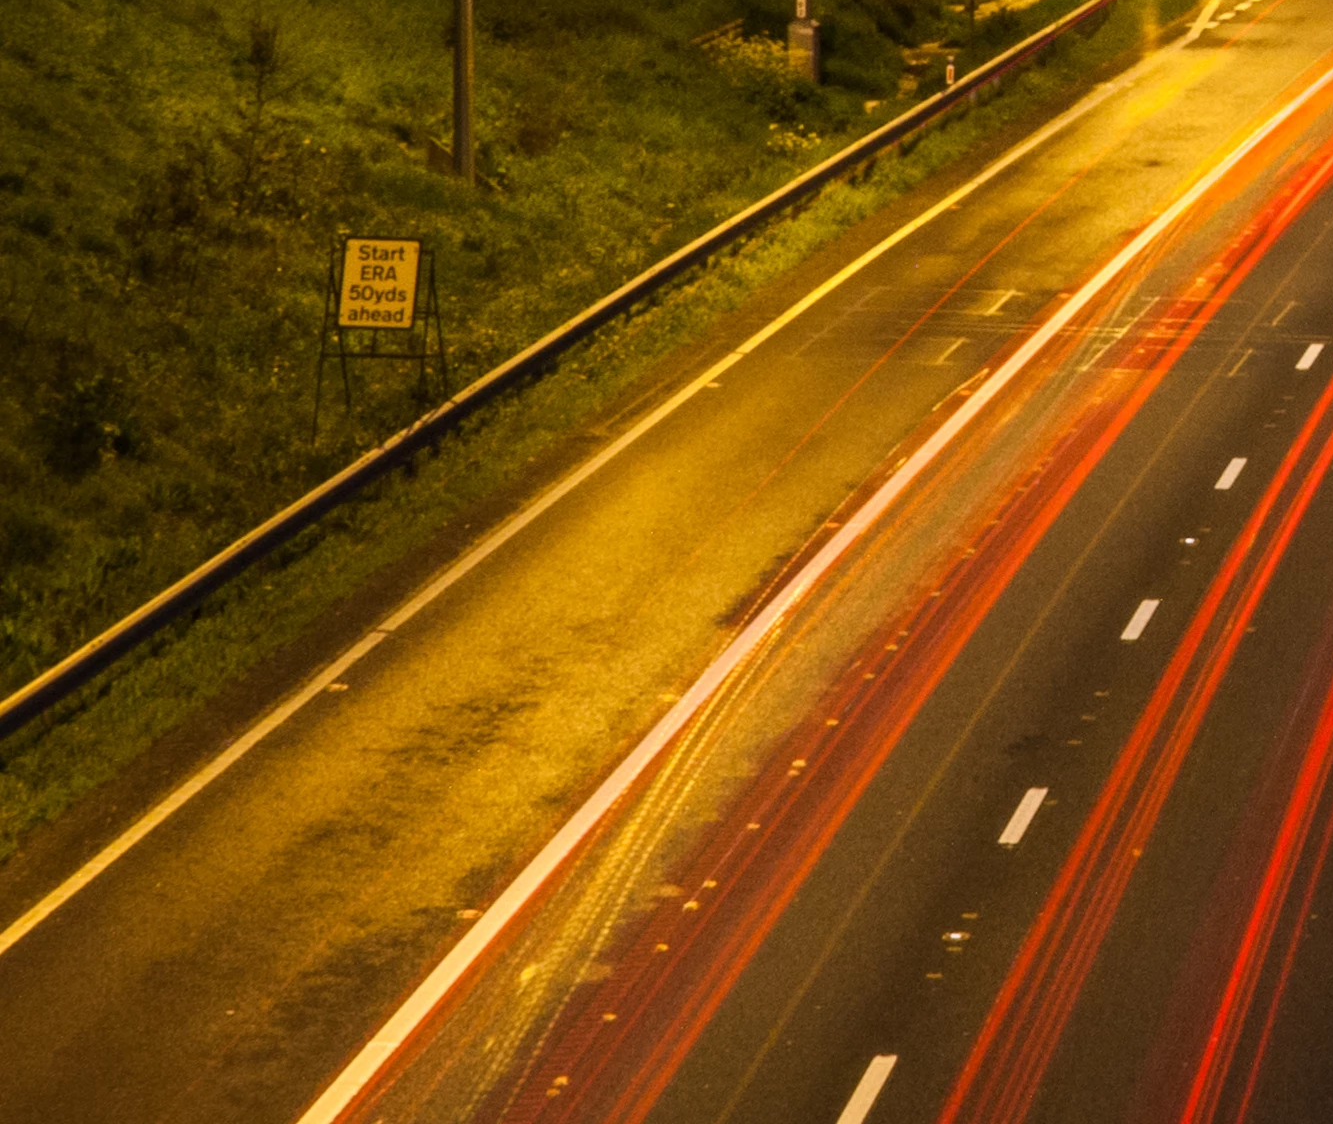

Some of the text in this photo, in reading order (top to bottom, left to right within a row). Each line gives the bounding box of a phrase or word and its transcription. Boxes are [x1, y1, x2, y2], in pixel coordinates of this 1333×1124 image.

[358, 245, 405, 261] Start
[360, 265, 397, 281] ERA
[349, 284, 407, 305] 50yds
[347, 306, 404, 323] ahead
